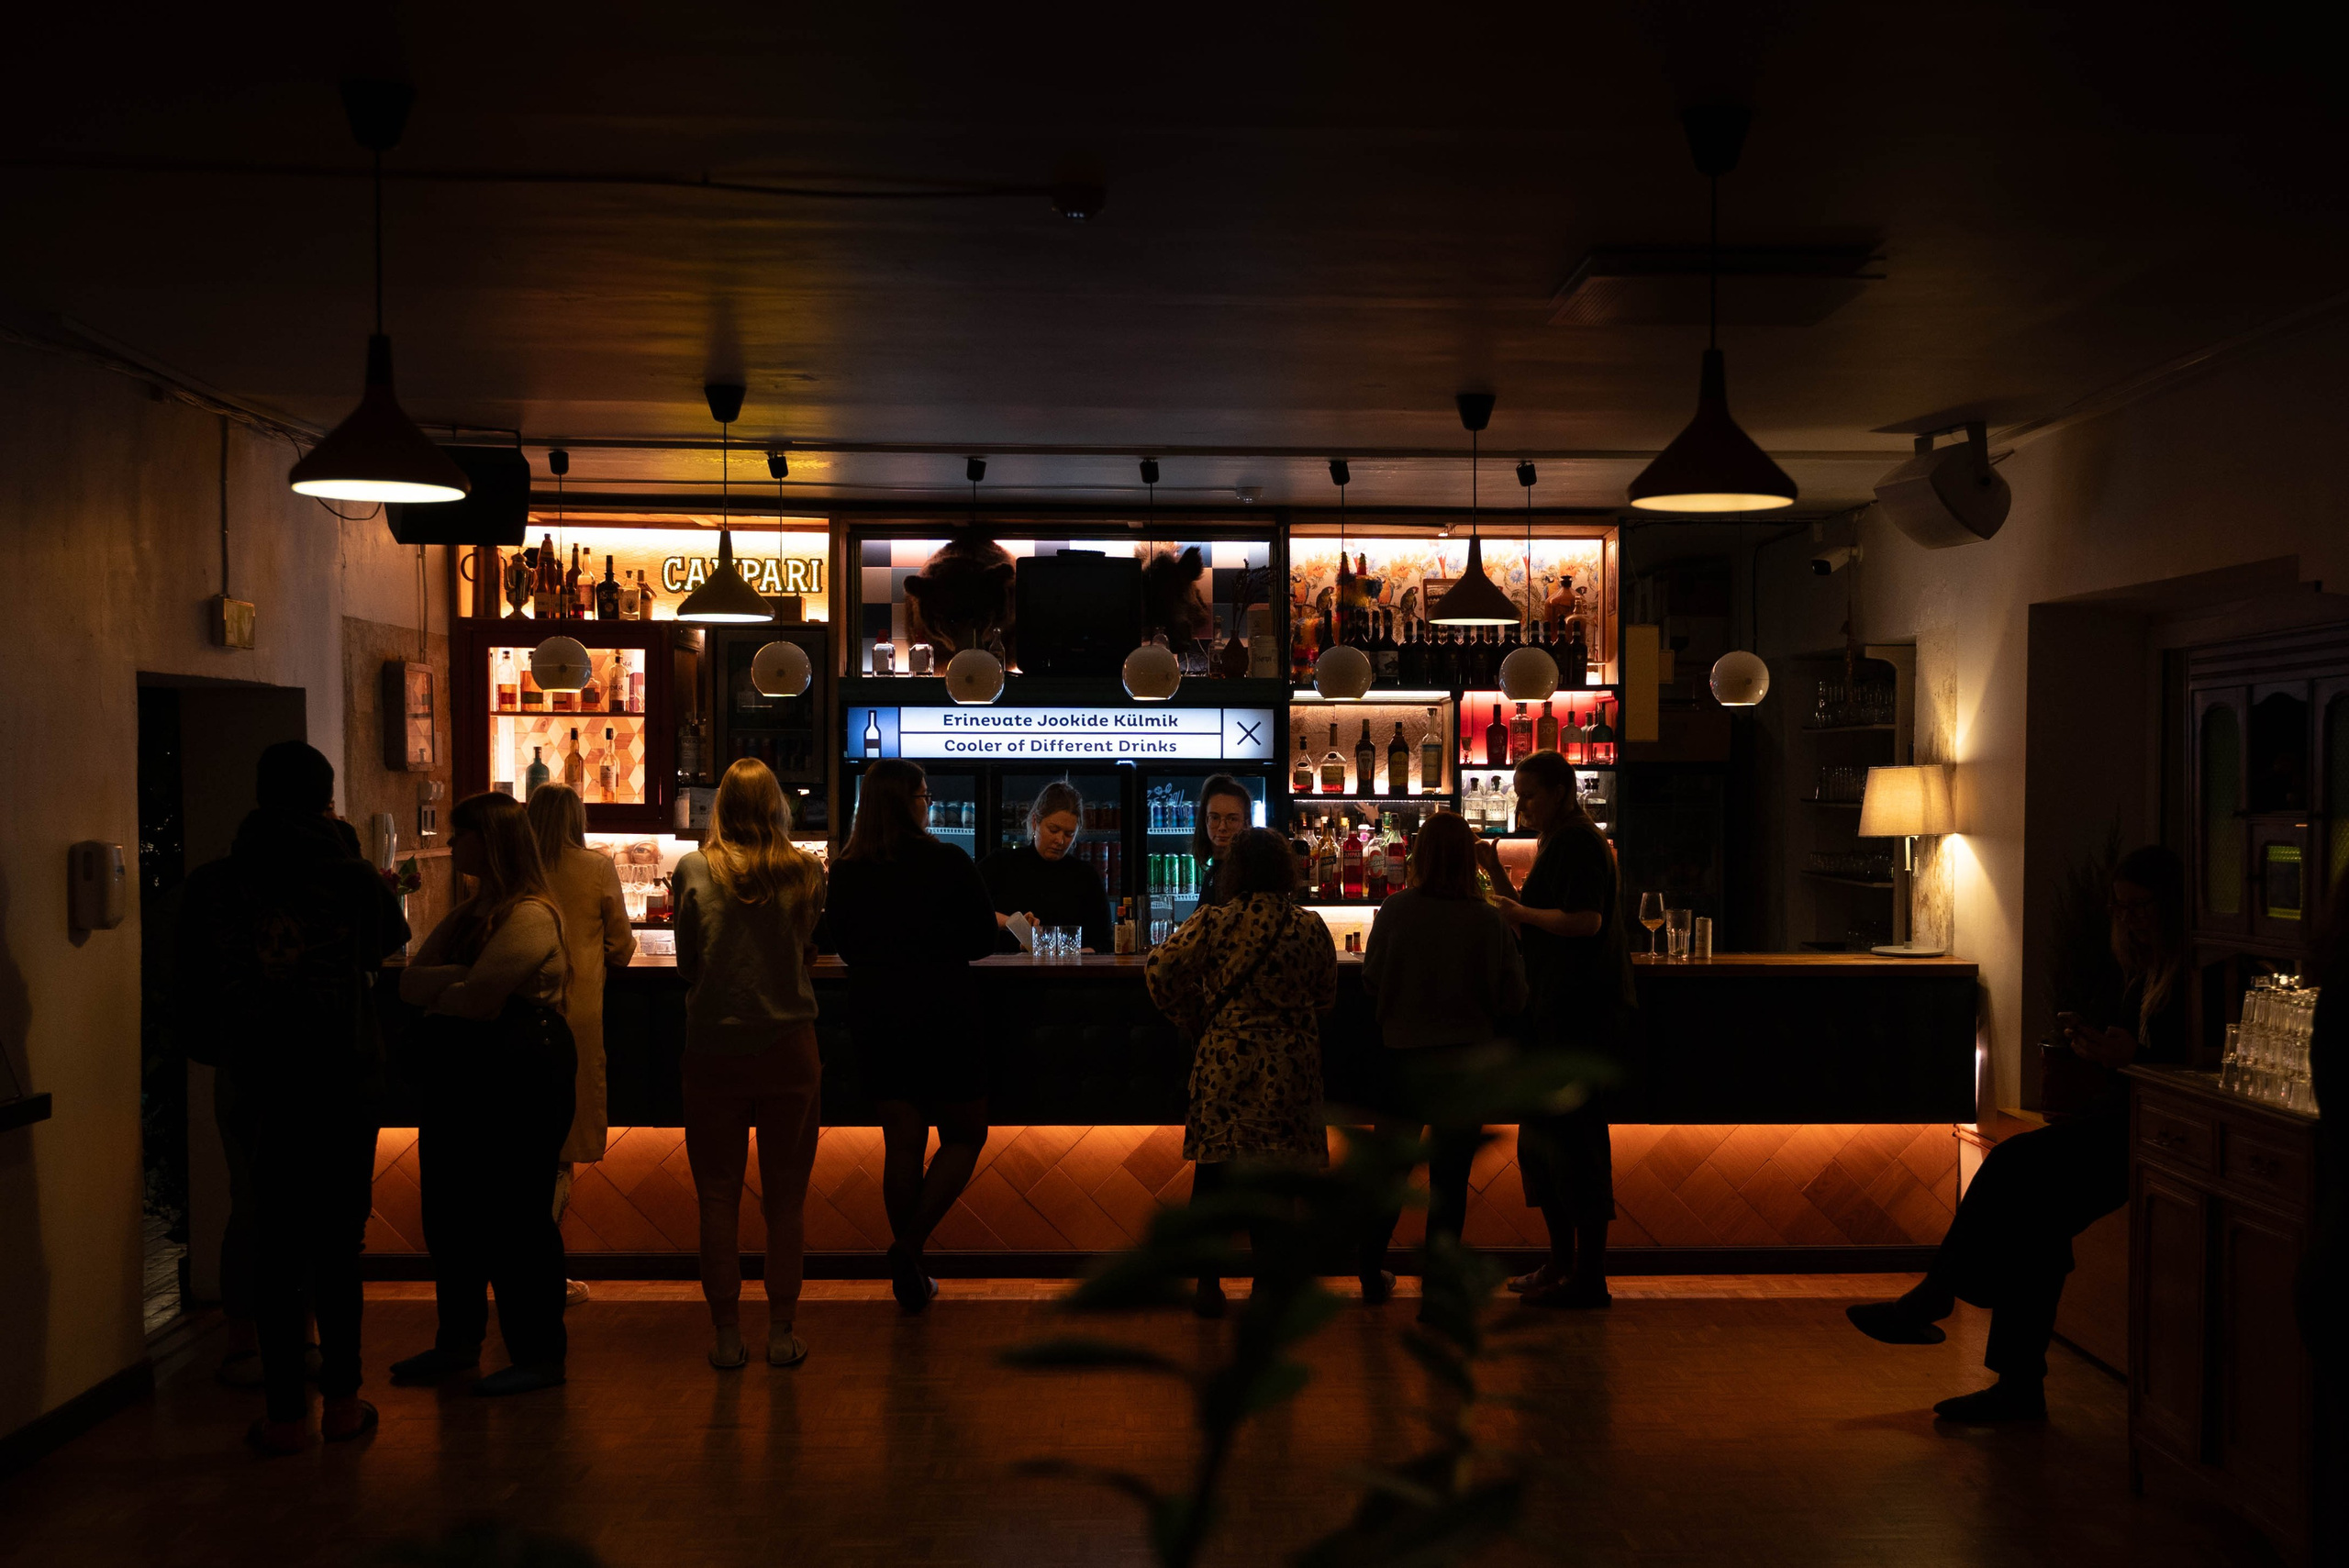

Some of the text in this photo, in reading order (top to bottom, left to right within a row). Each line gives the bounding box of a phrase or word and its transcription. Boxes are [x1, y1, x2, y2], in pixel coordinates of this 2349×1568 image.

[662, 556, 822, 593] CAPARI
[943, 713, 1178, 728] Erinevate Jookide Külmik
[944, 739, 1177, 752] Cooler of Different Drinks
